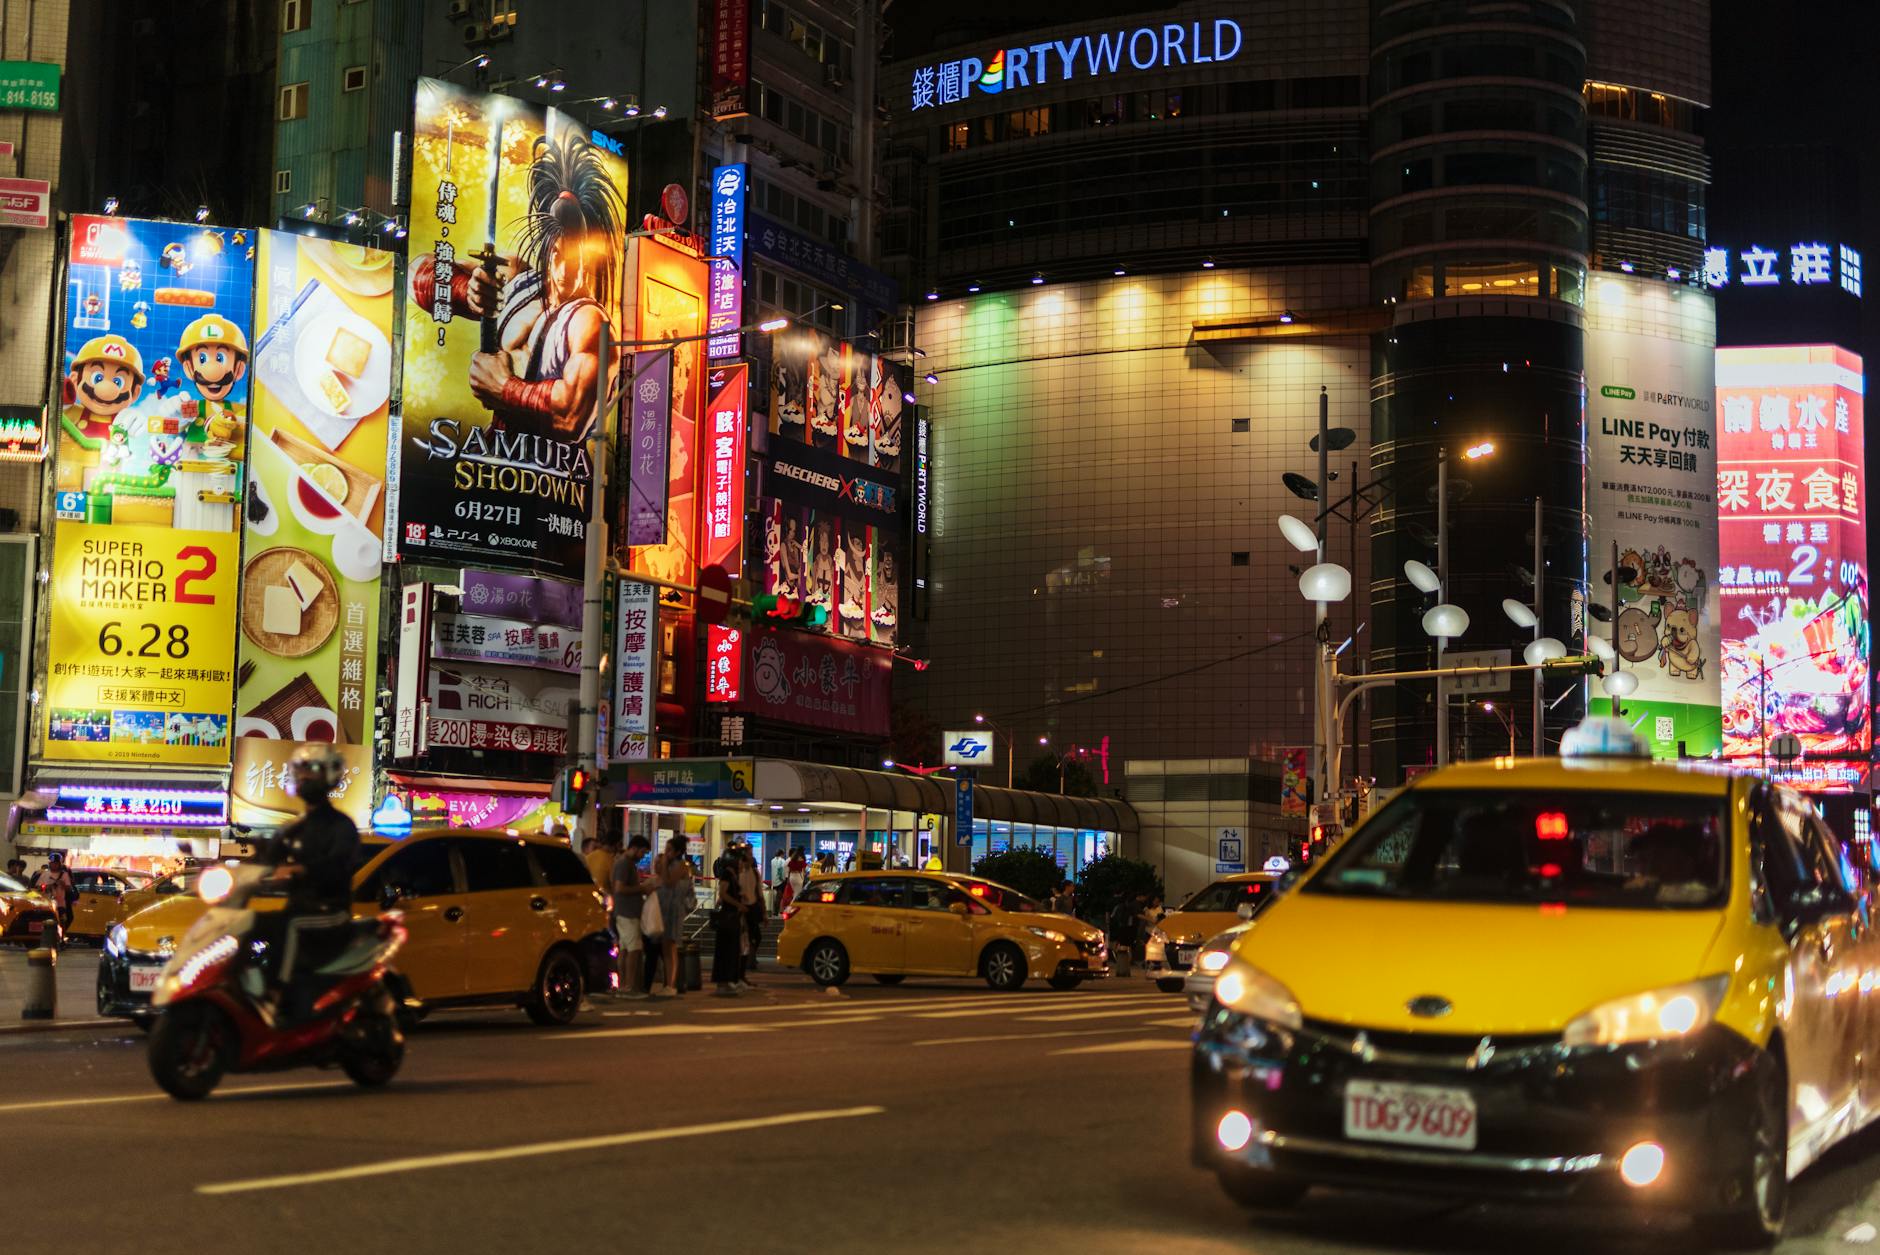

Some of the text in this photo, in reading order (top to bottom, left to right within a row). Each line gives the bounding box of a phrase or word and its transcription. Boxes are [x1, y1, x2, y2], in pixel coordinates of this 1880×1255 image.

[911, 19, 1243, 112] 錢櫃 PARTYWORLD
[591, 129, 626, 158] SNK
[715, 238, 723, 270] TIMO
[714, 272, 722, 306] HOTEL
[709, 344, 739, 357] HOTEL
[1605, 390, 1634, 400] LINE Pay
[640, 410, 657, 475] 湯の花
[1602, 417, 1710, 450] LINE Pay 付款
[430, 417, 591, 479] SAMURA
[1620, 444, 1697, 472] 天天享回饋
[454, 460, 587, 513] SHODOWN
[774, 461, 841, 492] SKECHERS
[1717, 467, 1859, 514] 深夜食堂
[455, 500, 521, 525] 6月27日
[447, 529, 481, 543] PS4
[536, 513, 584, 539] 一決勝負
[83, 539, 143, 557] SUPER
[500, 536, 522, 547] XBOX
[522, 538, 538, 550] ONE
[82, 556, 164, 580] MARIO
[175, 545, 218, 605] 2
[81, 579, 167, 603] MAKER
[490, 586, 534, 608] 湯の花
[623, 583, 651, 598] 玉芙蓉
[98, 621, 190, 660] 6.28
[441, 623, 486, 645] 玉芙蓉
[504, 628, 536, 647] 按摩
[624, 608, 648, 653] 按摩
[341, 601, 367, 711] 首選維格
[103, 688, 181, 703] 支援繁體中文
[468, 693, 511, 711] RICH
[621, 672, 645, 716] 護膚
[131, 751, 160, 760] Nintendo
[653, 768, 695, 785] 西門站
[731, 770, 745, 793] 6
[926, 818, 935, 830] 6
